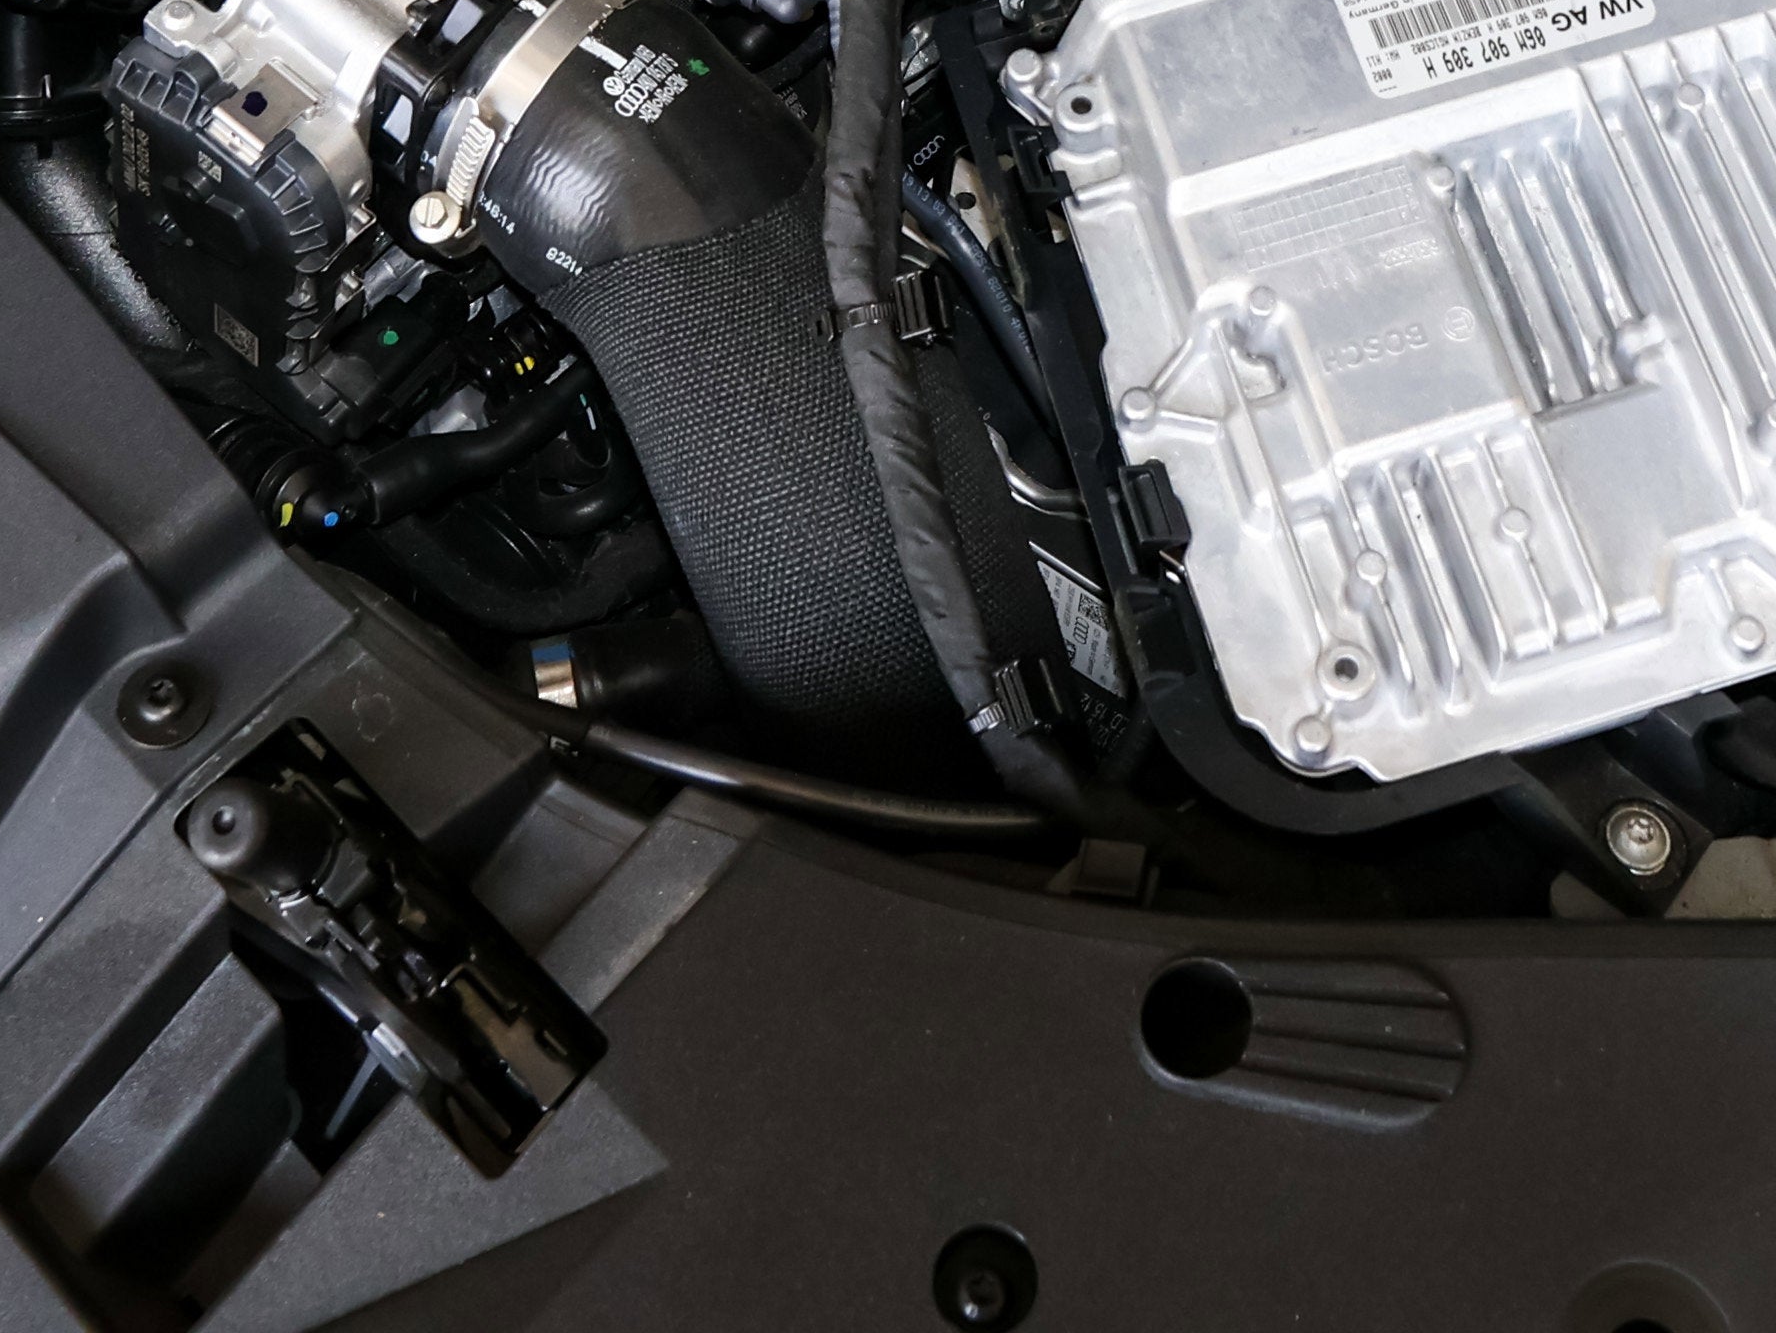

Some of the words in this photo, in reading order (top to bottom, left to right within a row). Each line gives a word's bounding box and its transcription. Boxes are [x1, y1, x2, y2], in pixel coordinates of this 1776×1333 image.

[1547, 4, 1593, 33] AG
[1476, 34, 1511, 63] 907
[1513, 24, 1547, 53] 06M
[1421, 55, 1437, 79] H
[1440, 45, 1474, 73] 309
[1319, 323, 1429, 374] BOSCH
